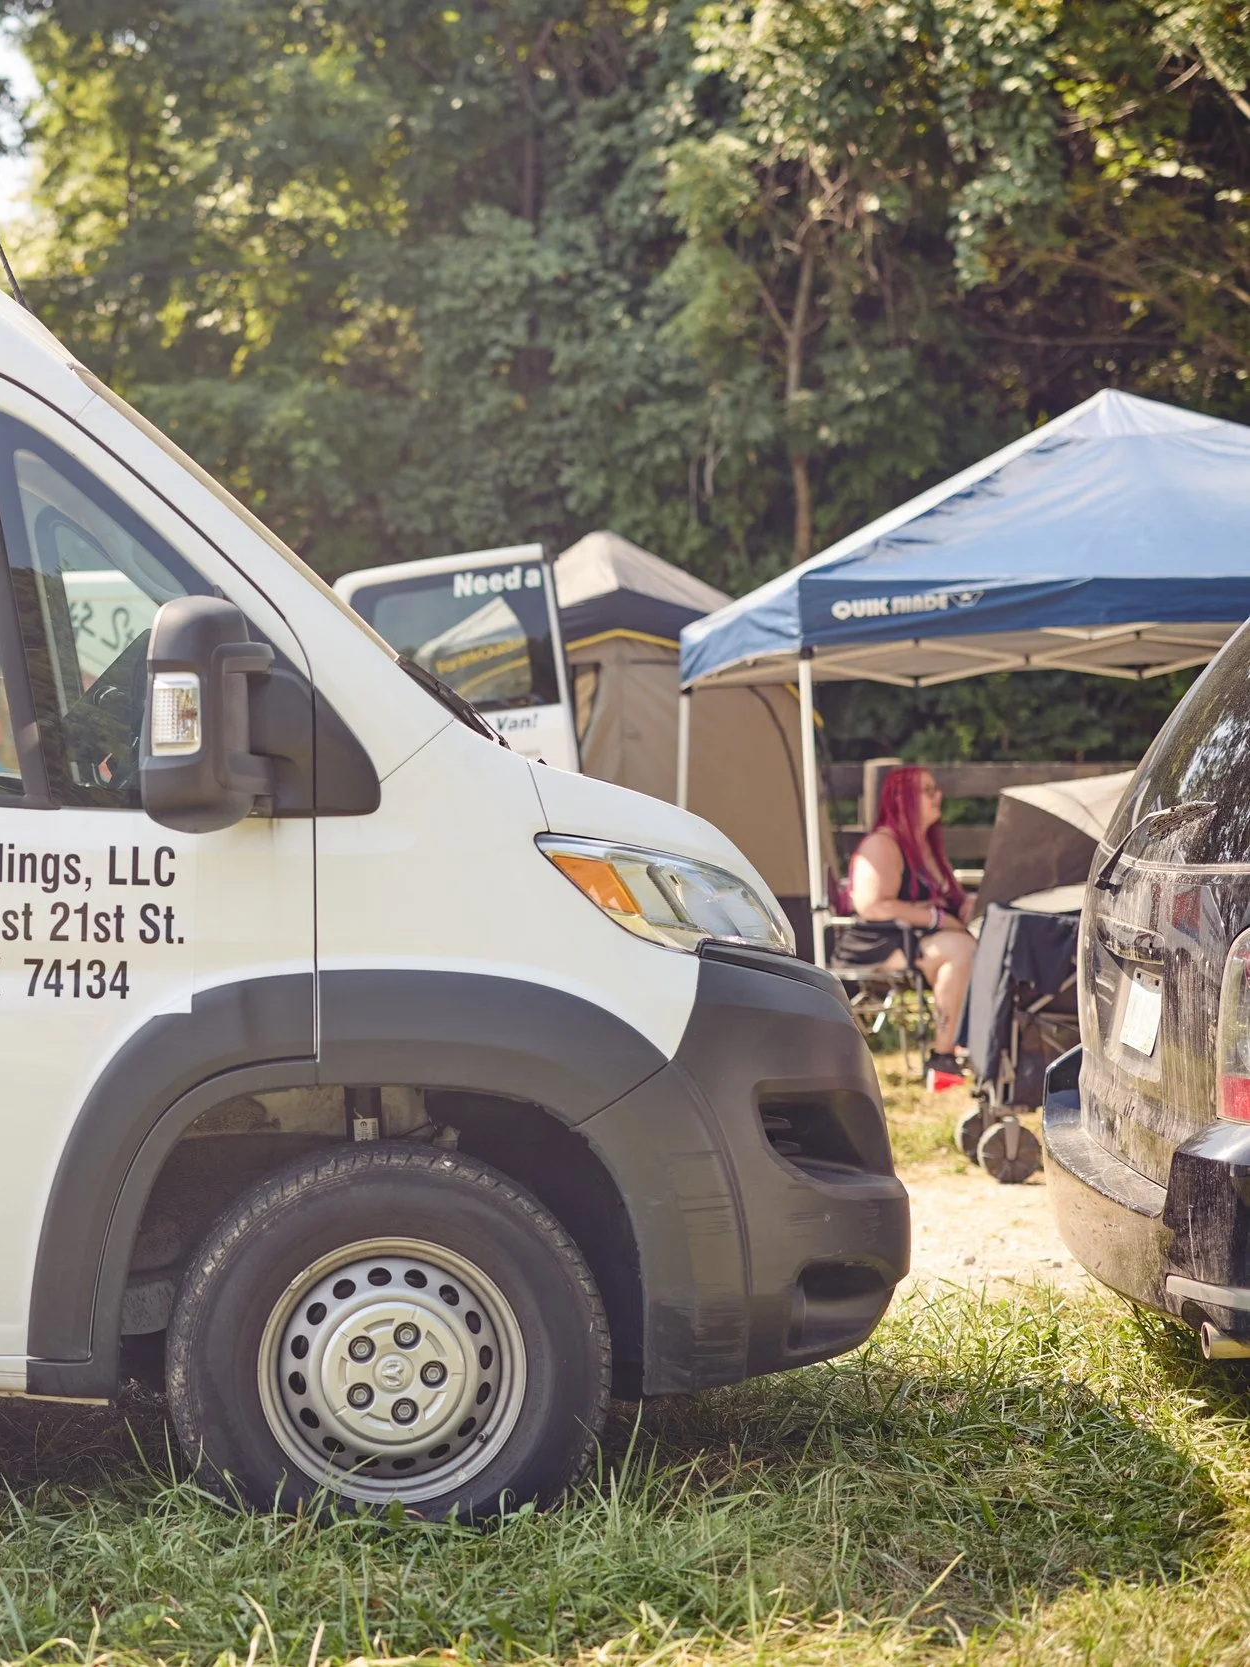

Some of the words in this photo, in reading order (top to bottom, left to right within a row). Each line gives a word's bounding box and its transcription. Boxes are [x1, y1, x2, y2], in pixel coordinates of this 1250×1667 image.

[453, 566, 522, 598] Need
[524, 568, 541, 588] a
[831, 598, 890, 620] QUIK
[497, 713, 539, 731] Van!
[108, 845, 176, 887] LLC
[49, 902, 125, 943] 21st
[139, 903, 184, 944] St.
[24, 957, 130, 999] 74134
